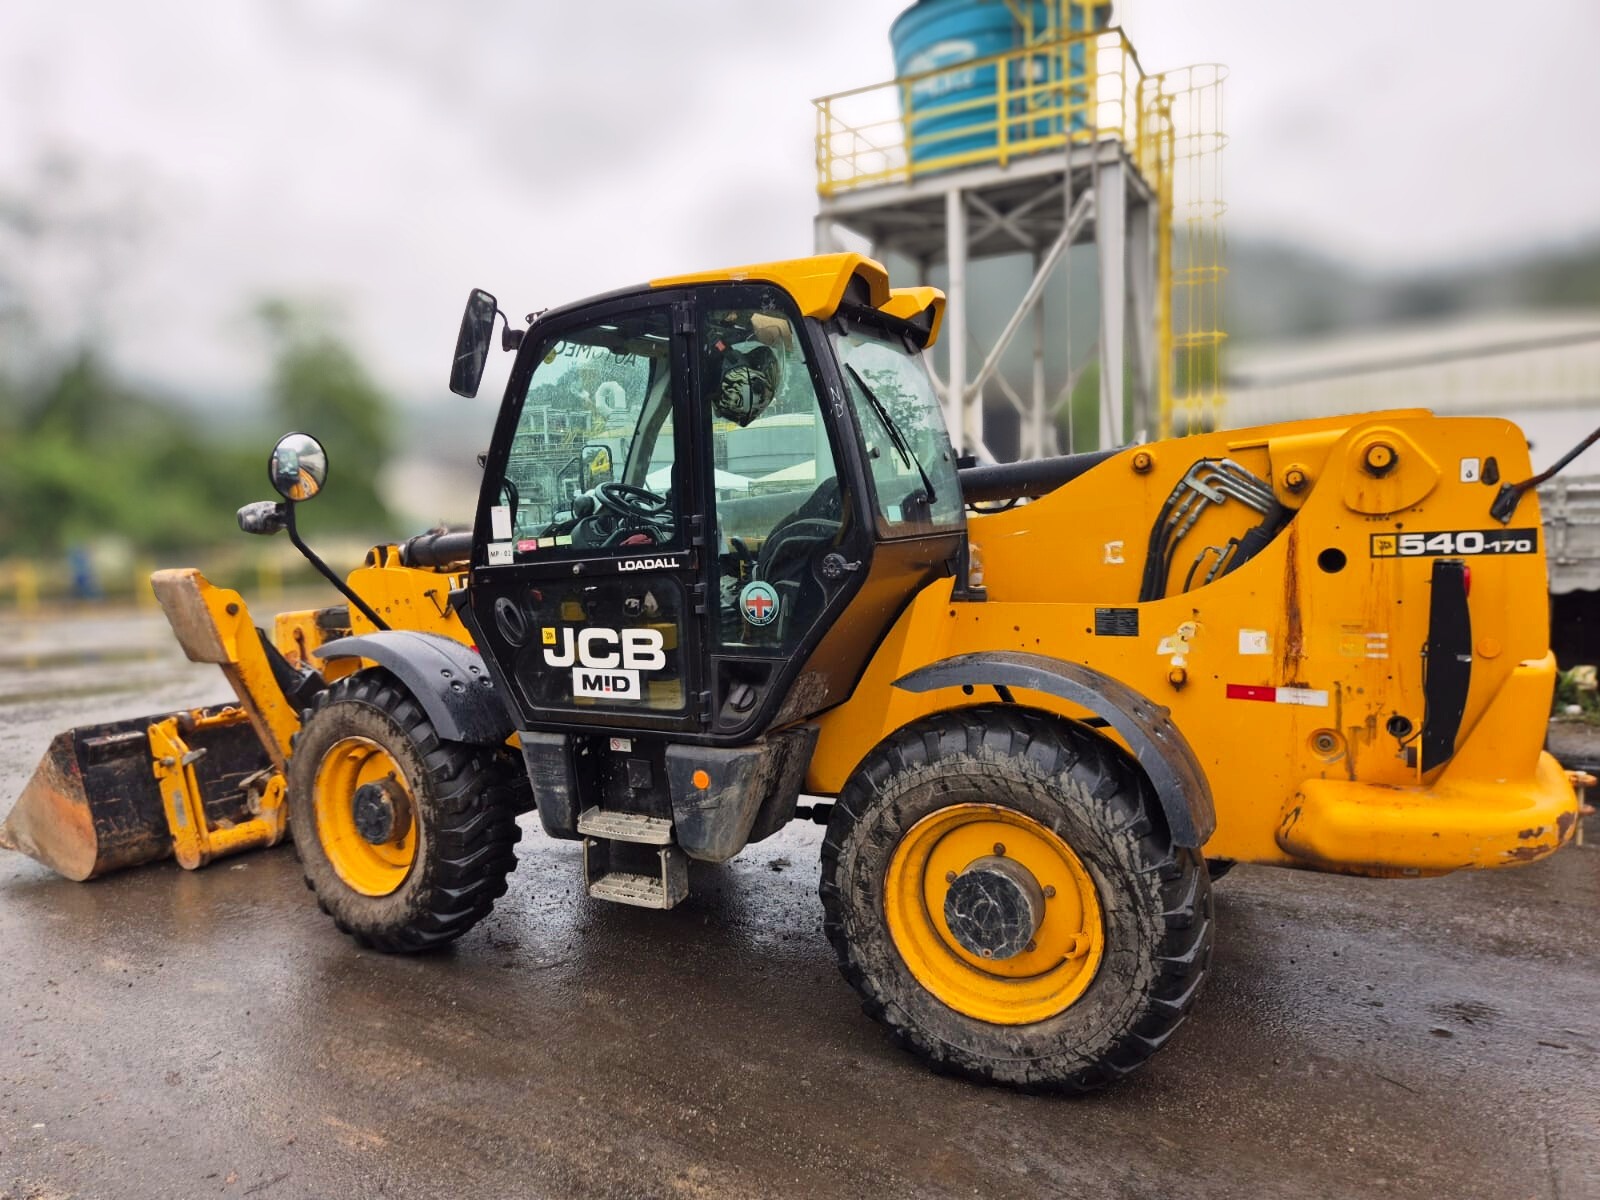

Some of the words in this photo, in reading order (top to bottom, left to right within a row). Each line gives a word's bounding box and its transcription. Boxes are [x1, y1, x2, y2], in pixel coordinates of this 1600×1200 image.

[1399, 531, 1531, 555] 540-170
[617, 557, 680, 571] LOADALL
[543, 627, 666, 670] JCB
